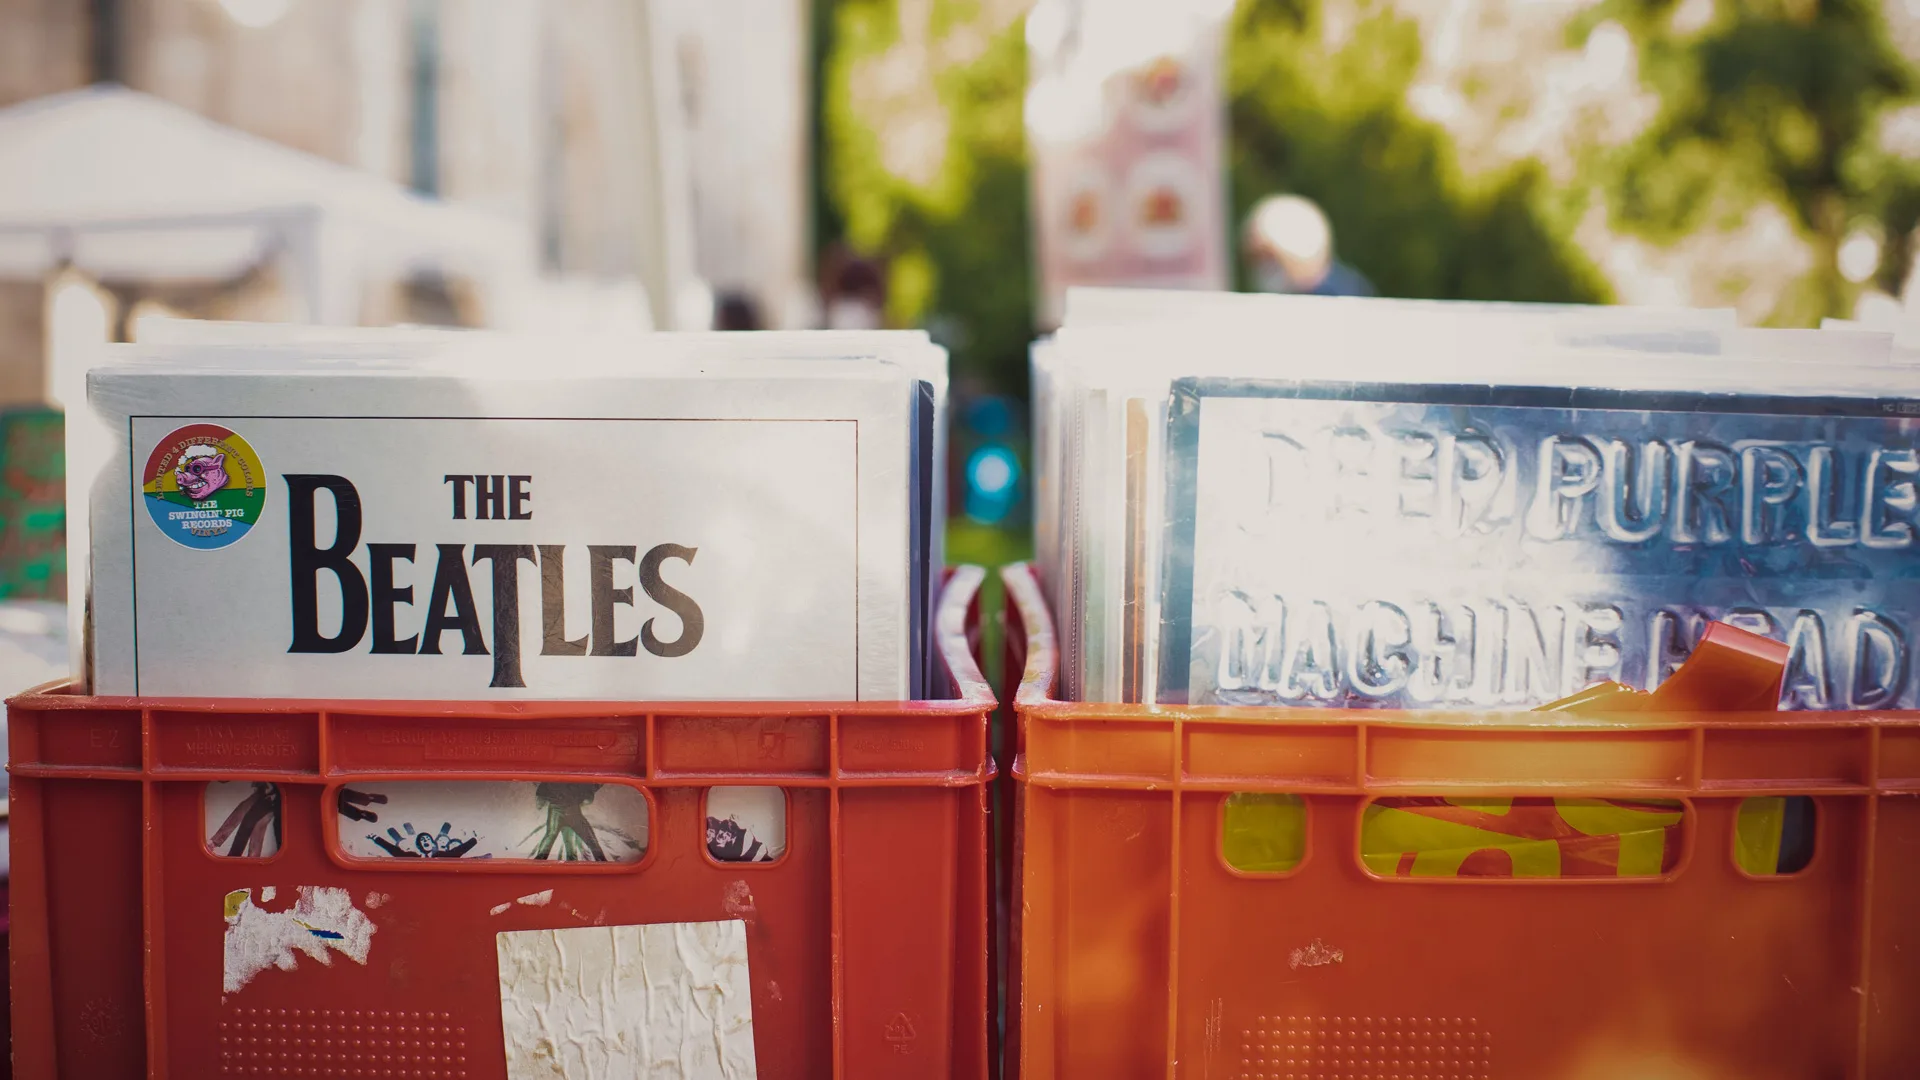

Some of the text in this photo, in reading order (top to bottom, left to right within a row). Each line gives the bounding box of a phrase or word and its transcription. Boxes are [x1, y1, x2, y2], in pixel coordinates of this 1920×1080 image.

[155, 436, 254, 501] LIMITED 4 DIFFERENT COLORS
[193, 500, 218, 509] THE
[444, 474, 533, 521] THE
[1526, 433, 1920, 547] PURPLE
[168, 508, 244, 520] SWINGIN' PIG
[182, 519, 232, 529] RECORDS
[191, 528, 228, 537] VINYL
[281, 473, 705, 688] BEATLES
[1215, 588, 1625, 703] MACHINE
[186, 742, 298, 757] MEHRWEGKASTEN
